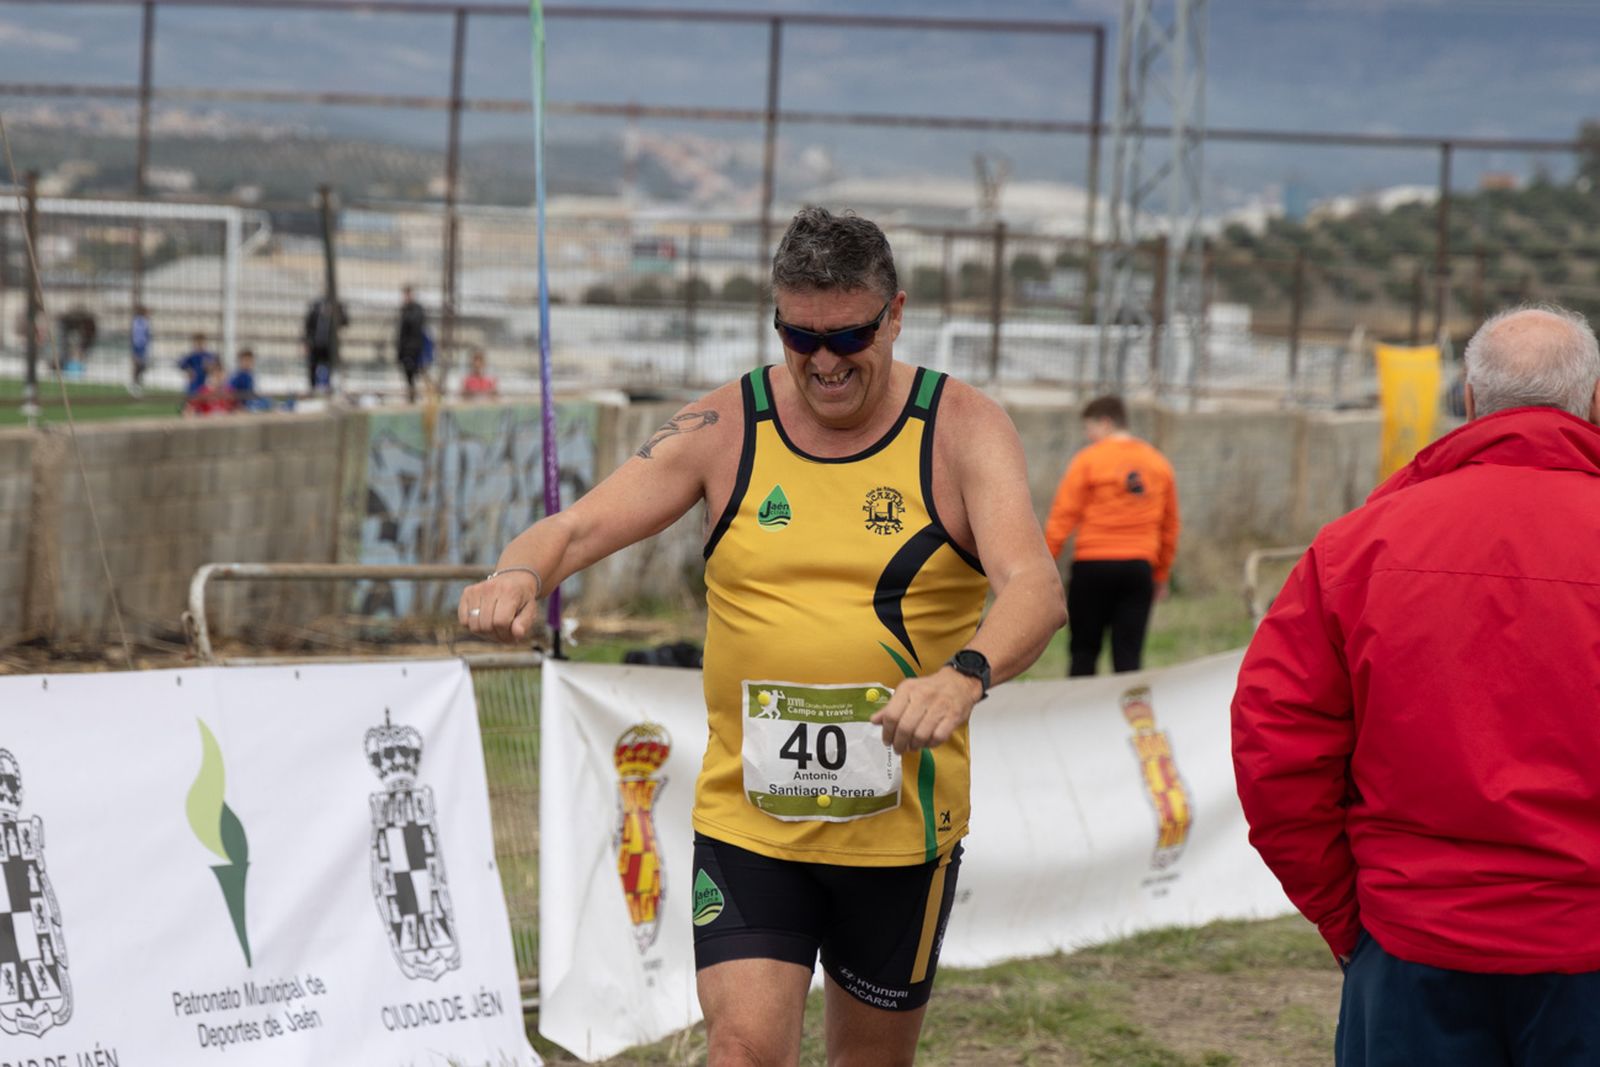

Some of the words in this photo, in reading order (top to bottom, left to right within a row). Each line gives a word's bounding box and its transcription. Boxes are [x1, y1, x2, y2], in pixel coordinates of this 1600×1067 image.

[759, 500, 790, 518] Jaén
[787, 706, 816, 717] Campo
[826, 707, 854, 717] través
[779, 723, 847, 771] 40
[793, 771, 838, 781] Antonio
[769, 784, 827, 798] Santiago
[831, 786, 875, 798] Perera
[172, 987, 241, 1017] Patronato
[243, 975, 306, 1007] Municipal
[305, 974, 327, 996] de
[845, 983, 898, 1008] JACARSA
[857, 978, 908, 998] HYUNDAI
[381, 1000, 441, 1031] CIUDAD
[441, 996, 467, 1022] DE
[197, 1019, 261, 1052] Deportes
[263, 1014, 284, 1038] de
[285, 1004, 323, 1032] Jaén
